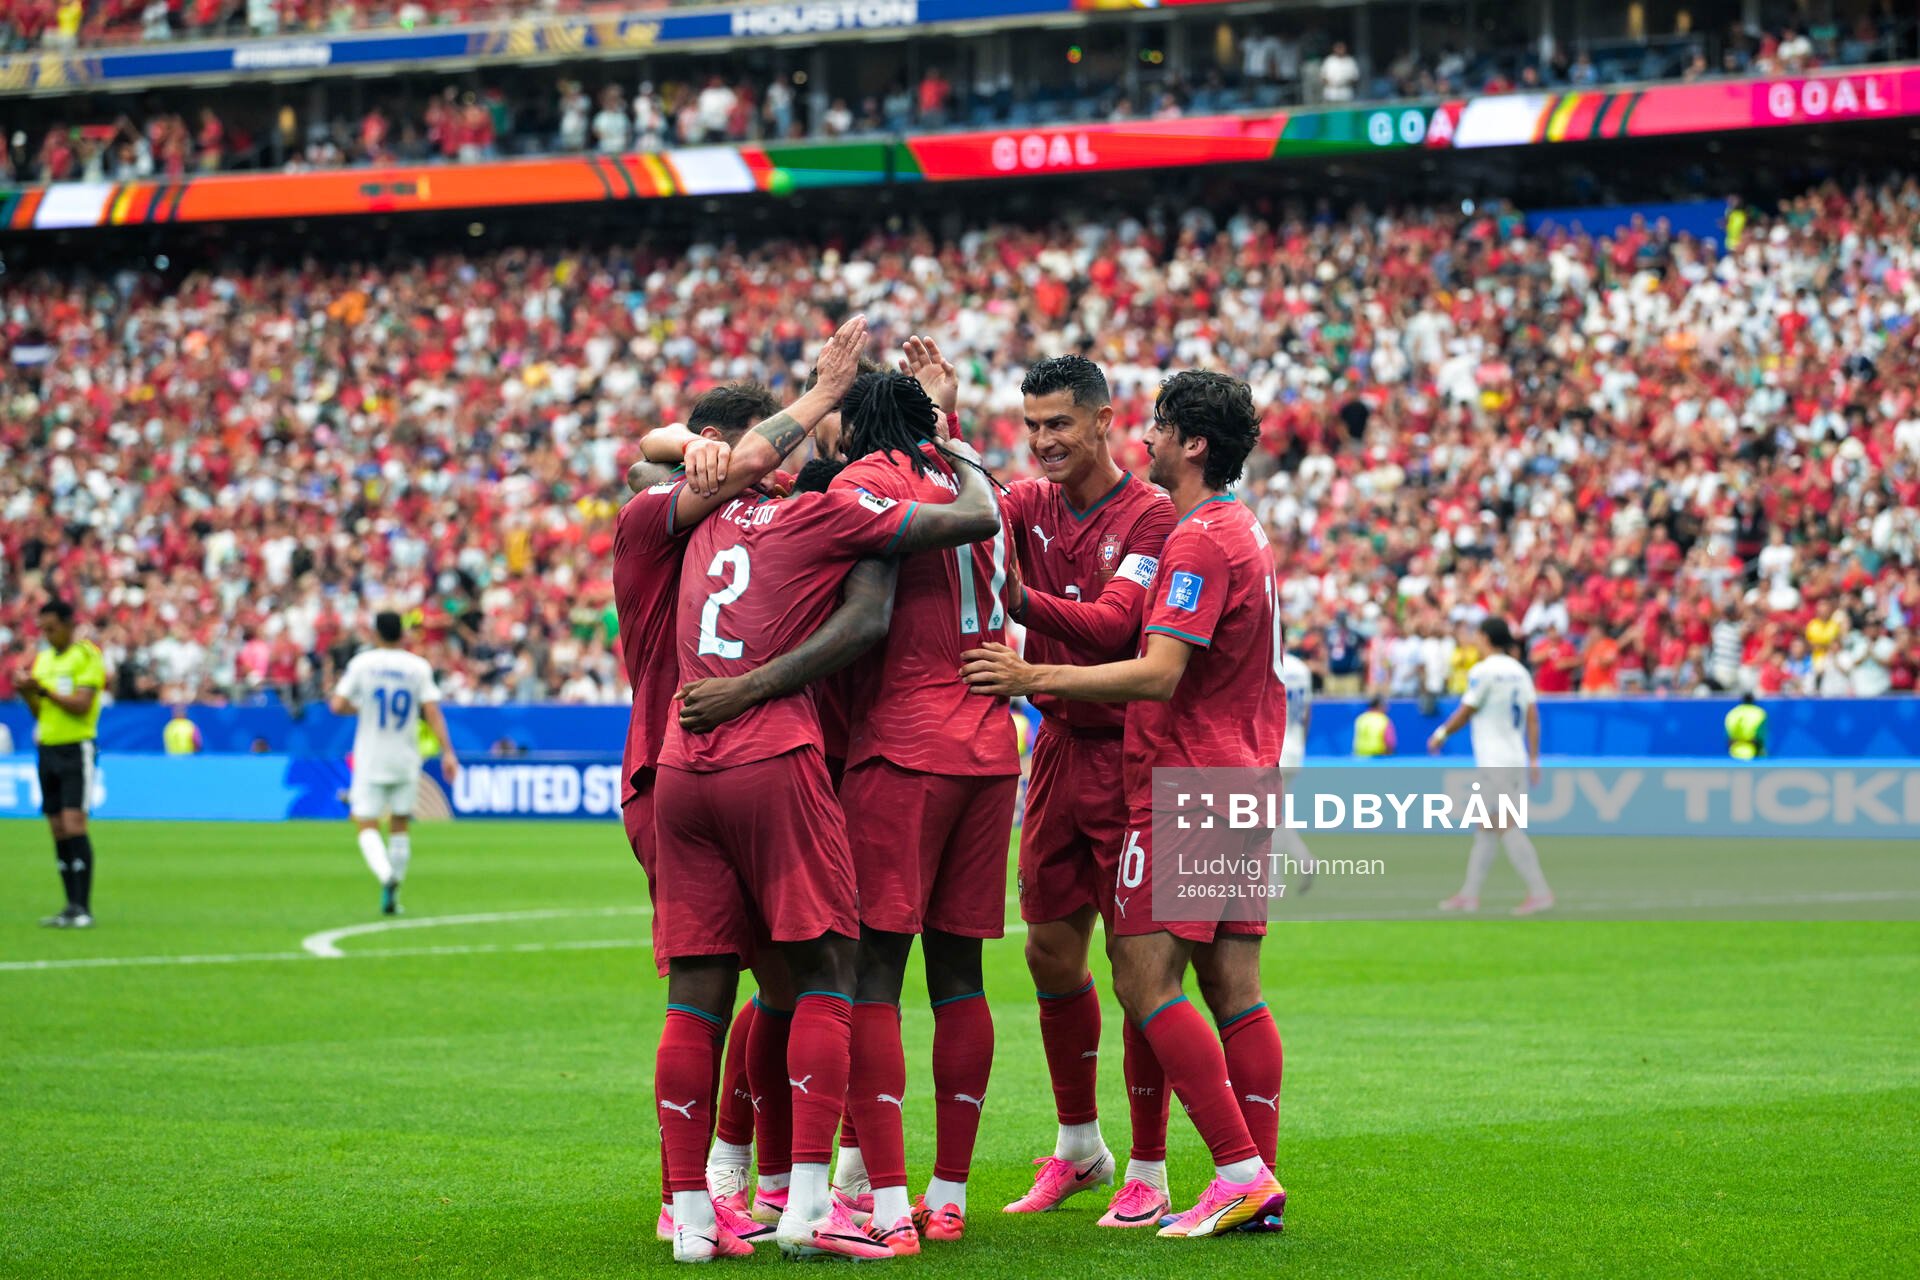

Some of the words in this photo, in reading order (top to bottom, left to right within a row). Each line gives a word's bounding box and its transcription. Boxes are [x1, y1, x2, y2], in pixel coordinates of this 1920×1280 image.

[731, 0, 918, 36] HOUSTON
[1767, 76, 1888, 118] GOAL
[991, 134, 1097, 172] GOAL
[698, 543, 750, 660] 2
[373, 686, 412, 731] 19
[453, 764, 581, 813] UNITED
[583, 764, 622, 814] ST
[1663, 770, 1920, 824] TICK
